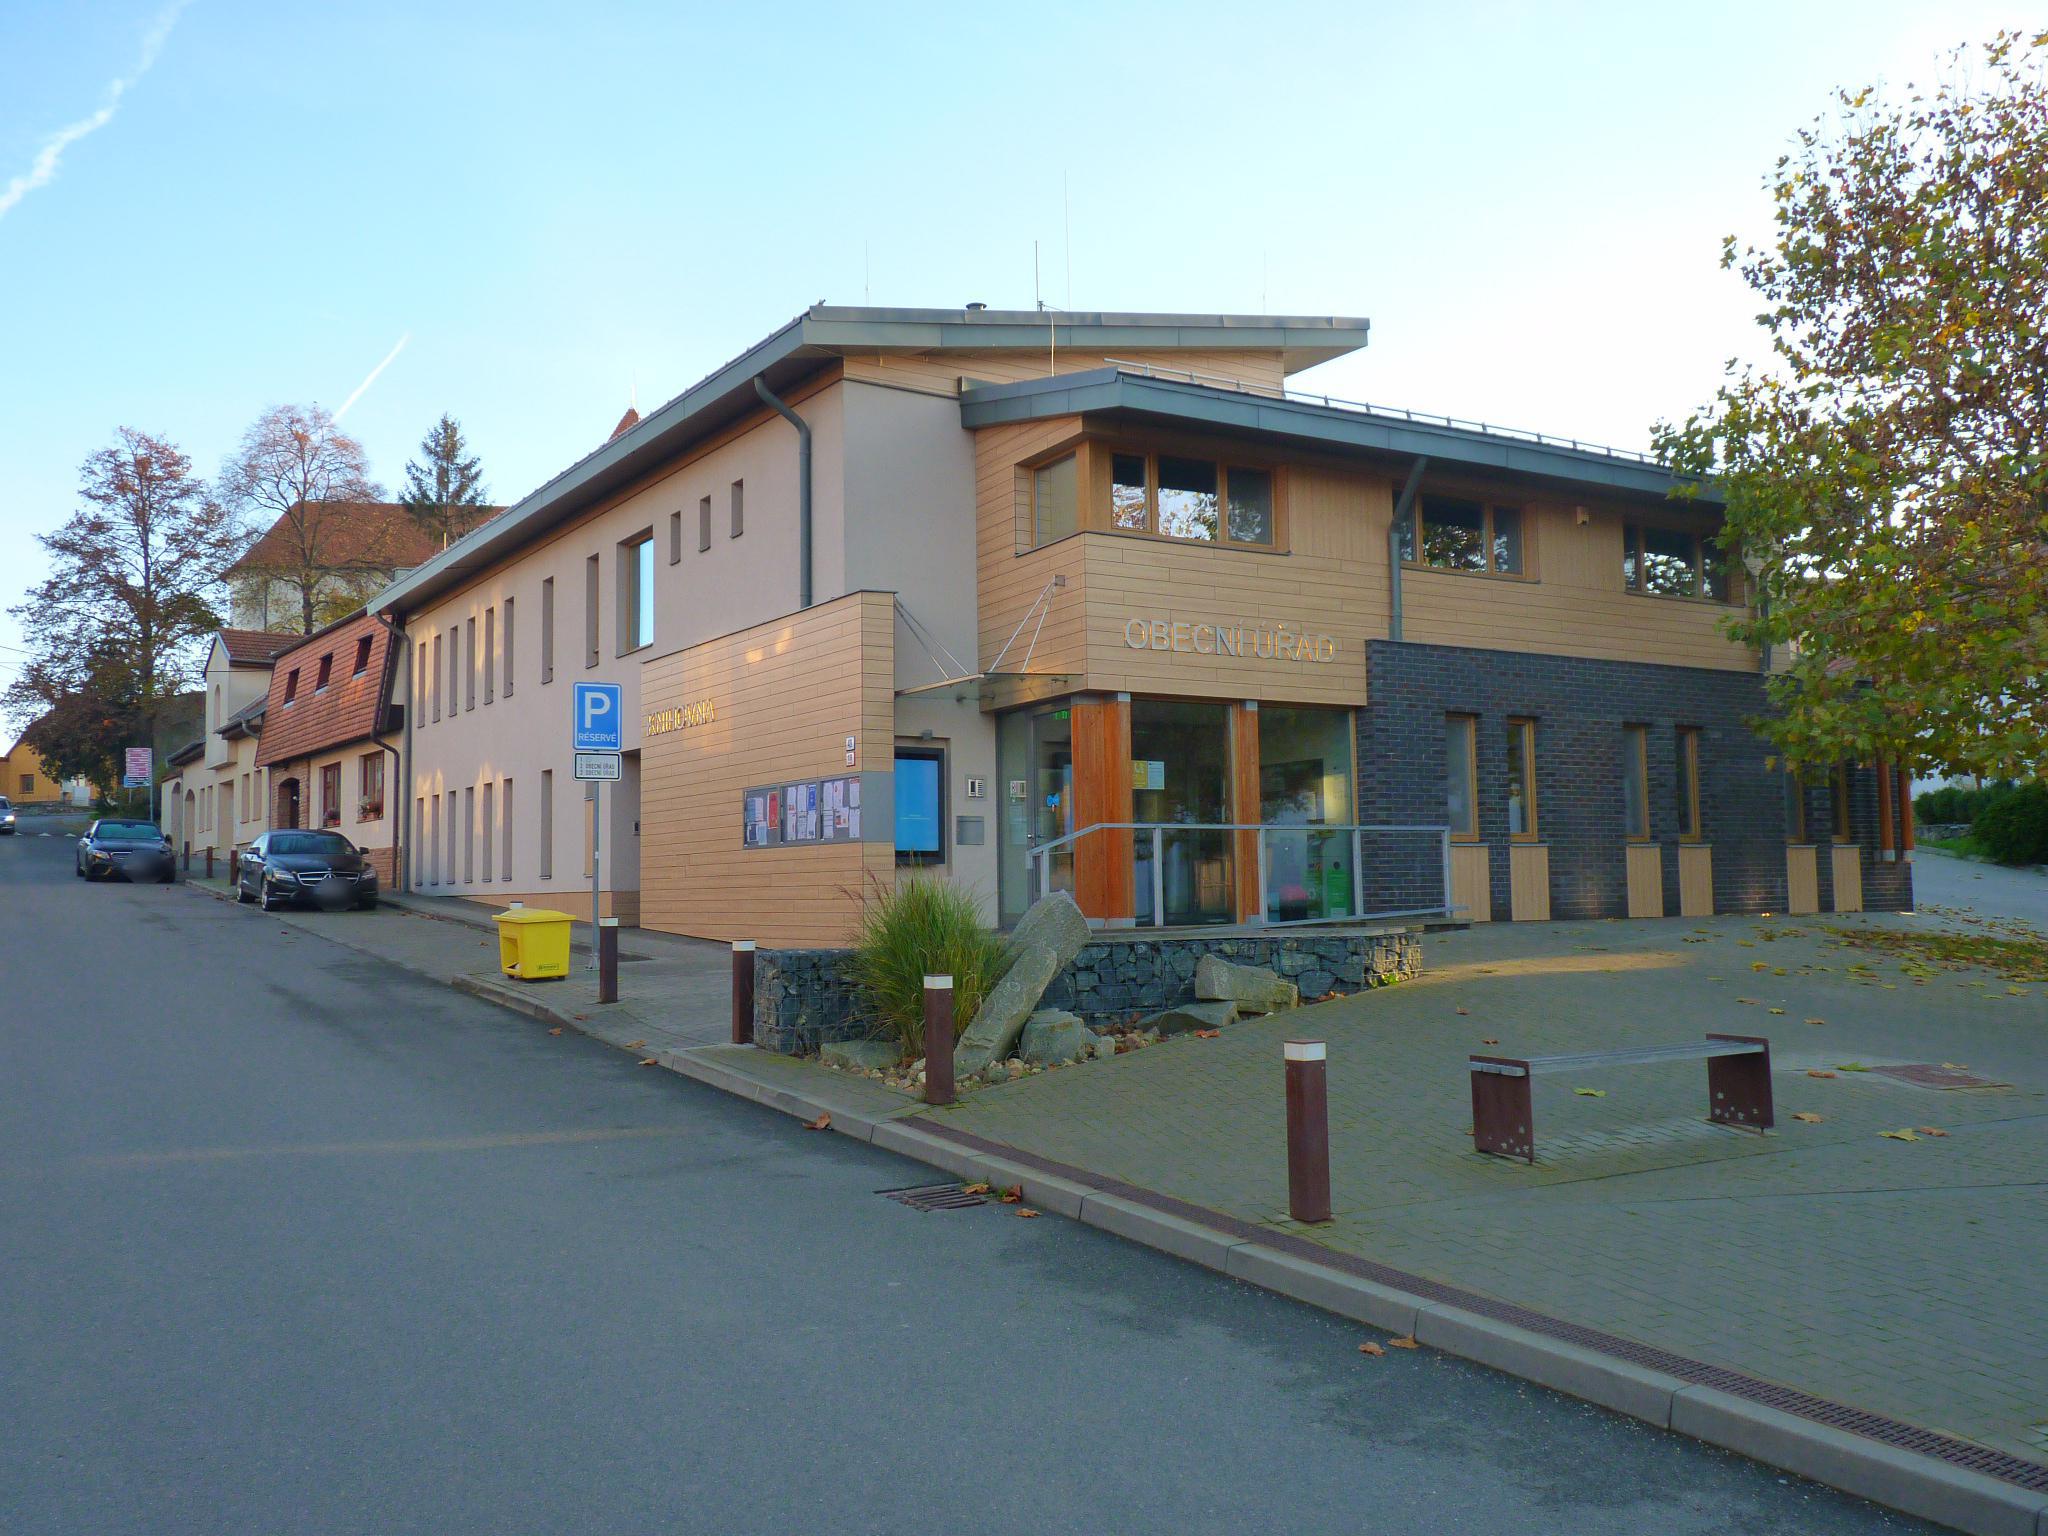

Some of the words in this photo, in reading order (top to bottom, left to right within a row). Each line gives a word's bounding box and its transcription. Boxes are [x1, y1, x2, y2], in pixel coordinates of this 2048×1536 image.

[1124, 618, 1244, 657] OBECNÍ
[1253, 619, 1336, 663] ÚŘAD
[584, 691, 611, 729] P
[646, 698, 715, 737] KNIHOVNA
[578, 731, 617, 742] RÉSERVÉ
